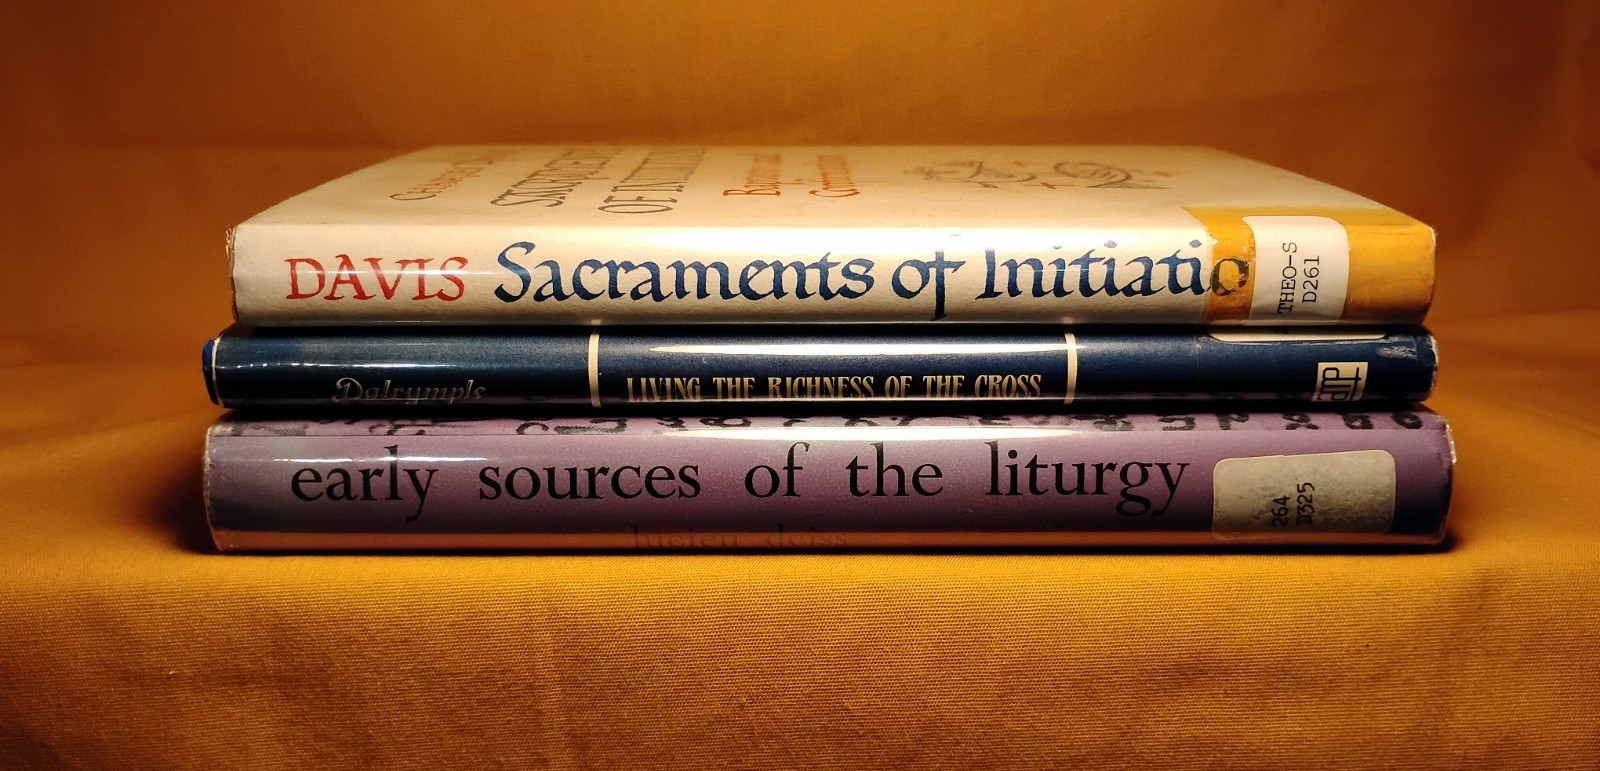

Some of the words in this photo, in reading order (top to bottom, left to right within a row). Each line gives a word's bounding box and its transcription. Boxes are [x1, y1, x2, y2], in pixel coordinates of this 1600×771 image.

[597, 195, 677, 214] OF
[284, 254, 470, 302] DAVIS
[494, 241, 875, 302] Sacraments
[891, 233, 966, 321] of
[975, 239, 1250, 300] Initiatio
[1277, 242, 1297, 314] THEO-S
[1302, 255, 1320, 303] D261
[332, 377, 489, 405] Dalrymple
[626, 377, 701, 402] LIVING
[713, 376, 755, 401] THE
[768, 376, 874, 400] RICHNESS
[885, 375, 913, 399] OF
[923, 375, 964, 399] THE
[975, 374, 1042, 399] CROSS
[291, 445, 438, 522] early
[479, 464, 701, 500] sources
[744, 441, 811, 498] of
[845, 442, 944, 497] the
[984, 440, 1190, 516] liturgy
[1271, 495, 1290, 527] 264
[630, 524, 738, 548] lucien
[766, 523, 848, 548] deiss
